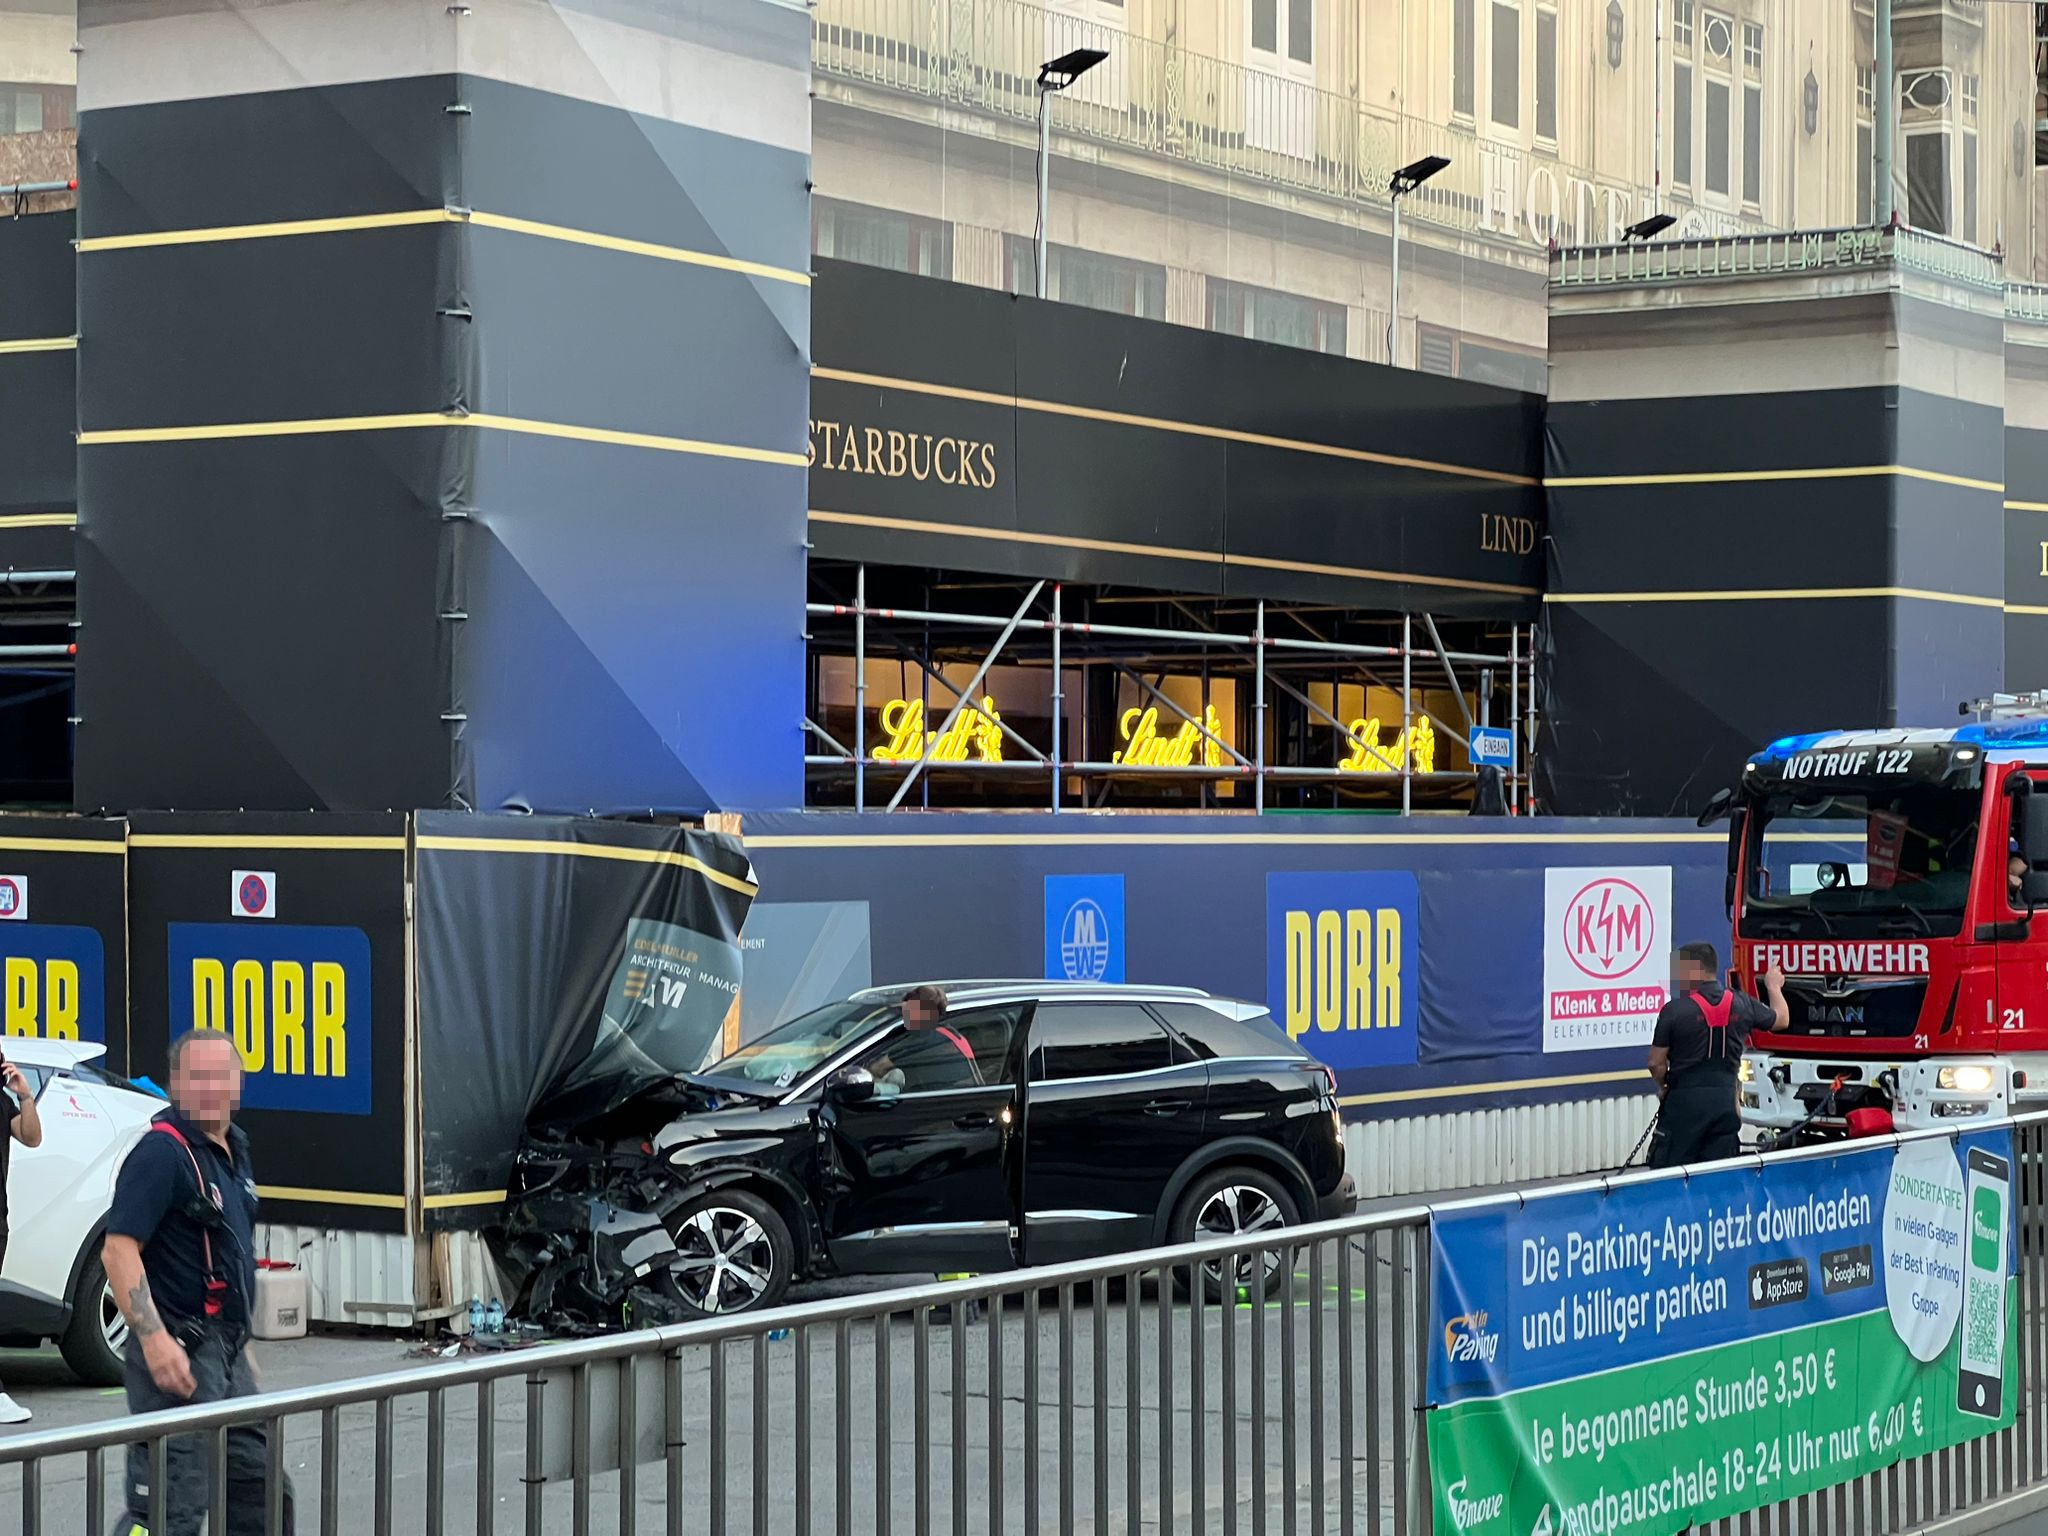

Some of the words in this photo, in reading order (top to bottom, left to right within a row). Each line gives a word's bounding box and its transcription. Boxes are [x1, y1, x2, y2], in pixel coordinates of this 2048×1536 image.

[1480, 513, 1540, 555] LIND
[1484, 738, 1508, 755] EINBAHN
[1782, 751, 1870, 780] NOTRUF
[1876, 749, 1913, 774] 122
[1753, 944, 1930, 973] FEUERWEHR
[1554, 994, 1597, 1016] Klenk
[1601, 994, 1612, 1014] &
[1617, 992, 1661, 1012] Meder
[1807, 1006, 1865, 1023] MAN
[1554, 1020, 1653, 1039] ELEKTROTECHNI
[2003, 1009, 2024, 1029] 21
[1915, 1035, 1929, 1049] 21
[1894, 1172, 1962, 1210] SONDERTARFE
[1522, 1236, 1560, 1287] Die
[1567, 1216, 1703, 1279] Parking-App
[1707, 1203, 1752, 1265] jetzt
[1757, 1187, 1871, 1243] downloaden
[1895, 1211, 1902, 1231] in
[1903, 1214, 1926, 1238] vielen
[1928, 1221, 1959, 1249] Gaagen
[1833, 1264, 1856, 1284] Google
[1856, 1262, 1870, 1280] Play
[1891, 1249, 1903, 1269] der
[1905, 1252, 1924, 1275] Best
[1767, 1282, 1781, 1302] App
[1782, 1278, 1803, 1296] Store
[1522, 1296, 1566, 1351] und
[1573, 1287, 1650, 1344] billiger
[1656, 1272, 1728, 1334] parken
[1533, 1419, 1554, 1466] Je
[1562, 1394, 1688, 1463] begonnene
[1696, 1366, 1768, 1424] Stunde
[1775, 1352, 1818, 1408] 3,50
[1824, 1348, 1836, 1390] €
[1722, 1437, 1782, 1495] 18-24
[1788, 1430, 1823, 1476] Uhr
[1829, 1424, 1861, 1464] nur
[1868, 1401, 1905, 1455] 6,00
[1912, 1395, 1924, 1437] €
